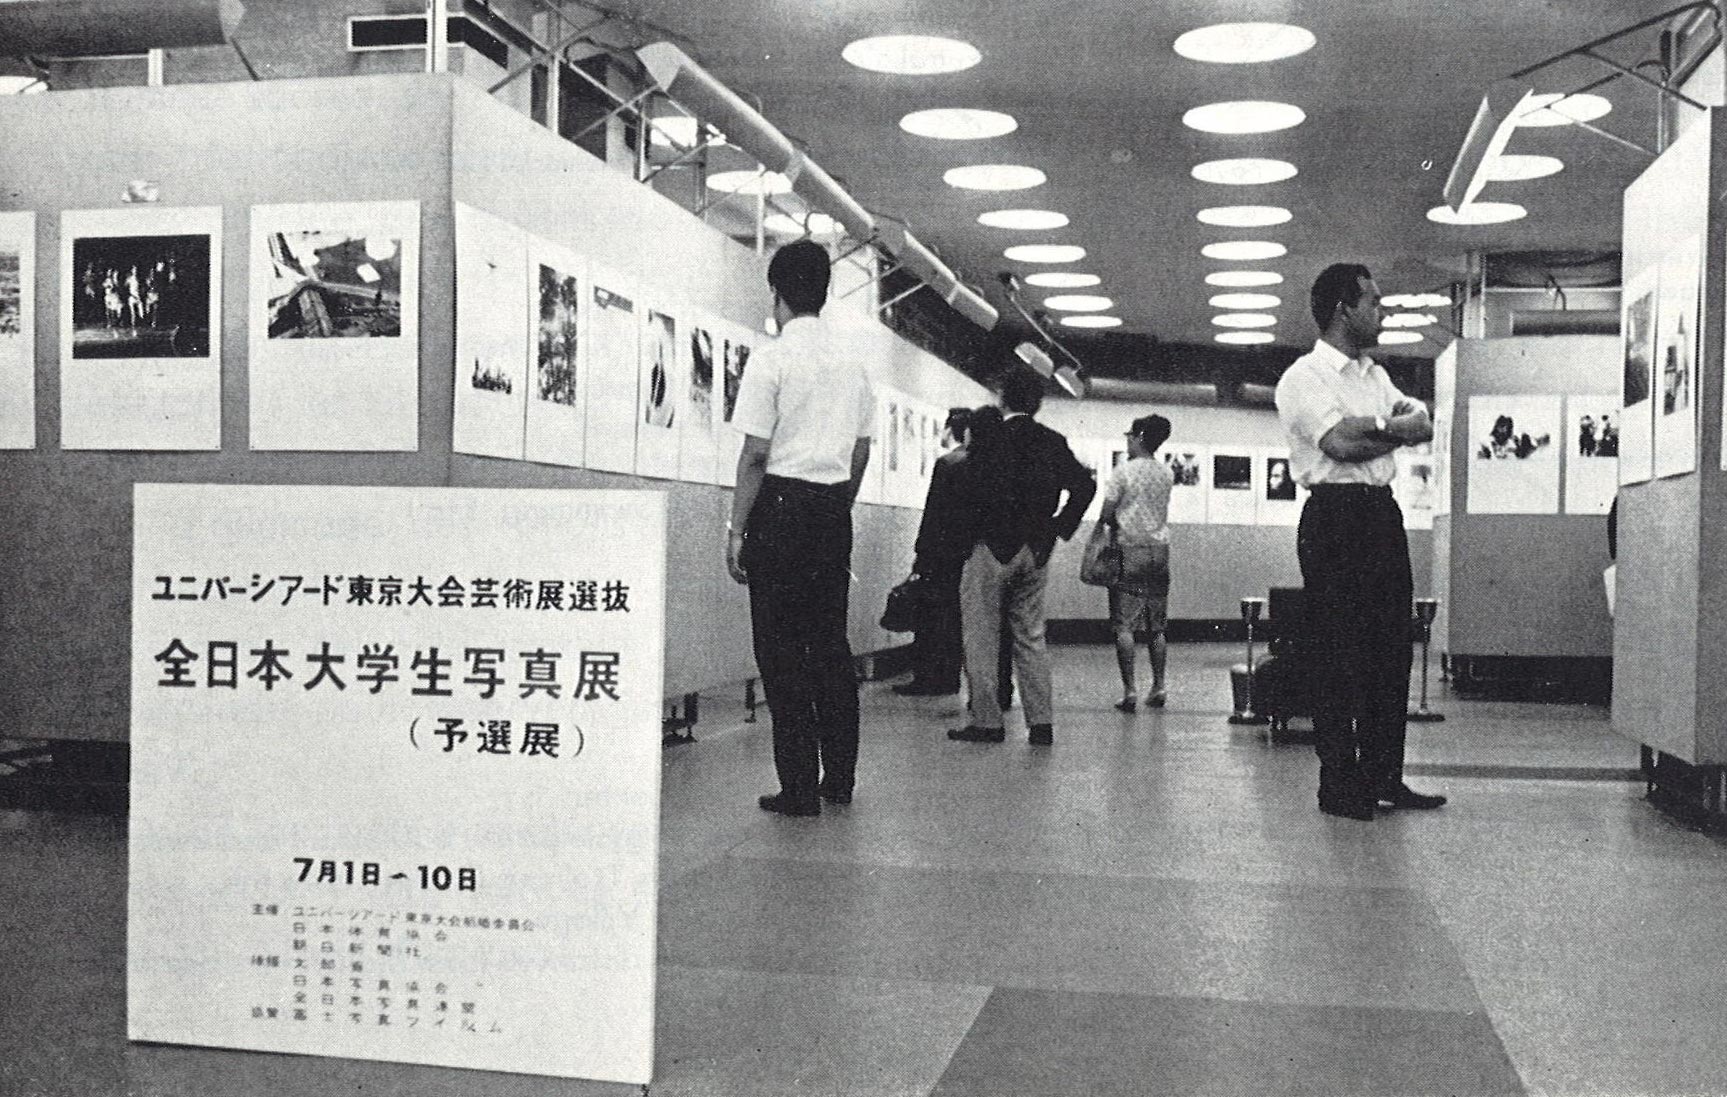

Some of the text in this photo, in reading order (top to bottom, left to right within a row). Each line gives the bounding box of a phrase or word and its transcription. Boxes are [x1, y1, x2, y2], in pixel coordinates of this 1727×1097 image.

[152, 574, 631, 613] ユニバーシアード東京大会芸術展選抜
[154, 638, 622, 702] 全日本大学生写真展
